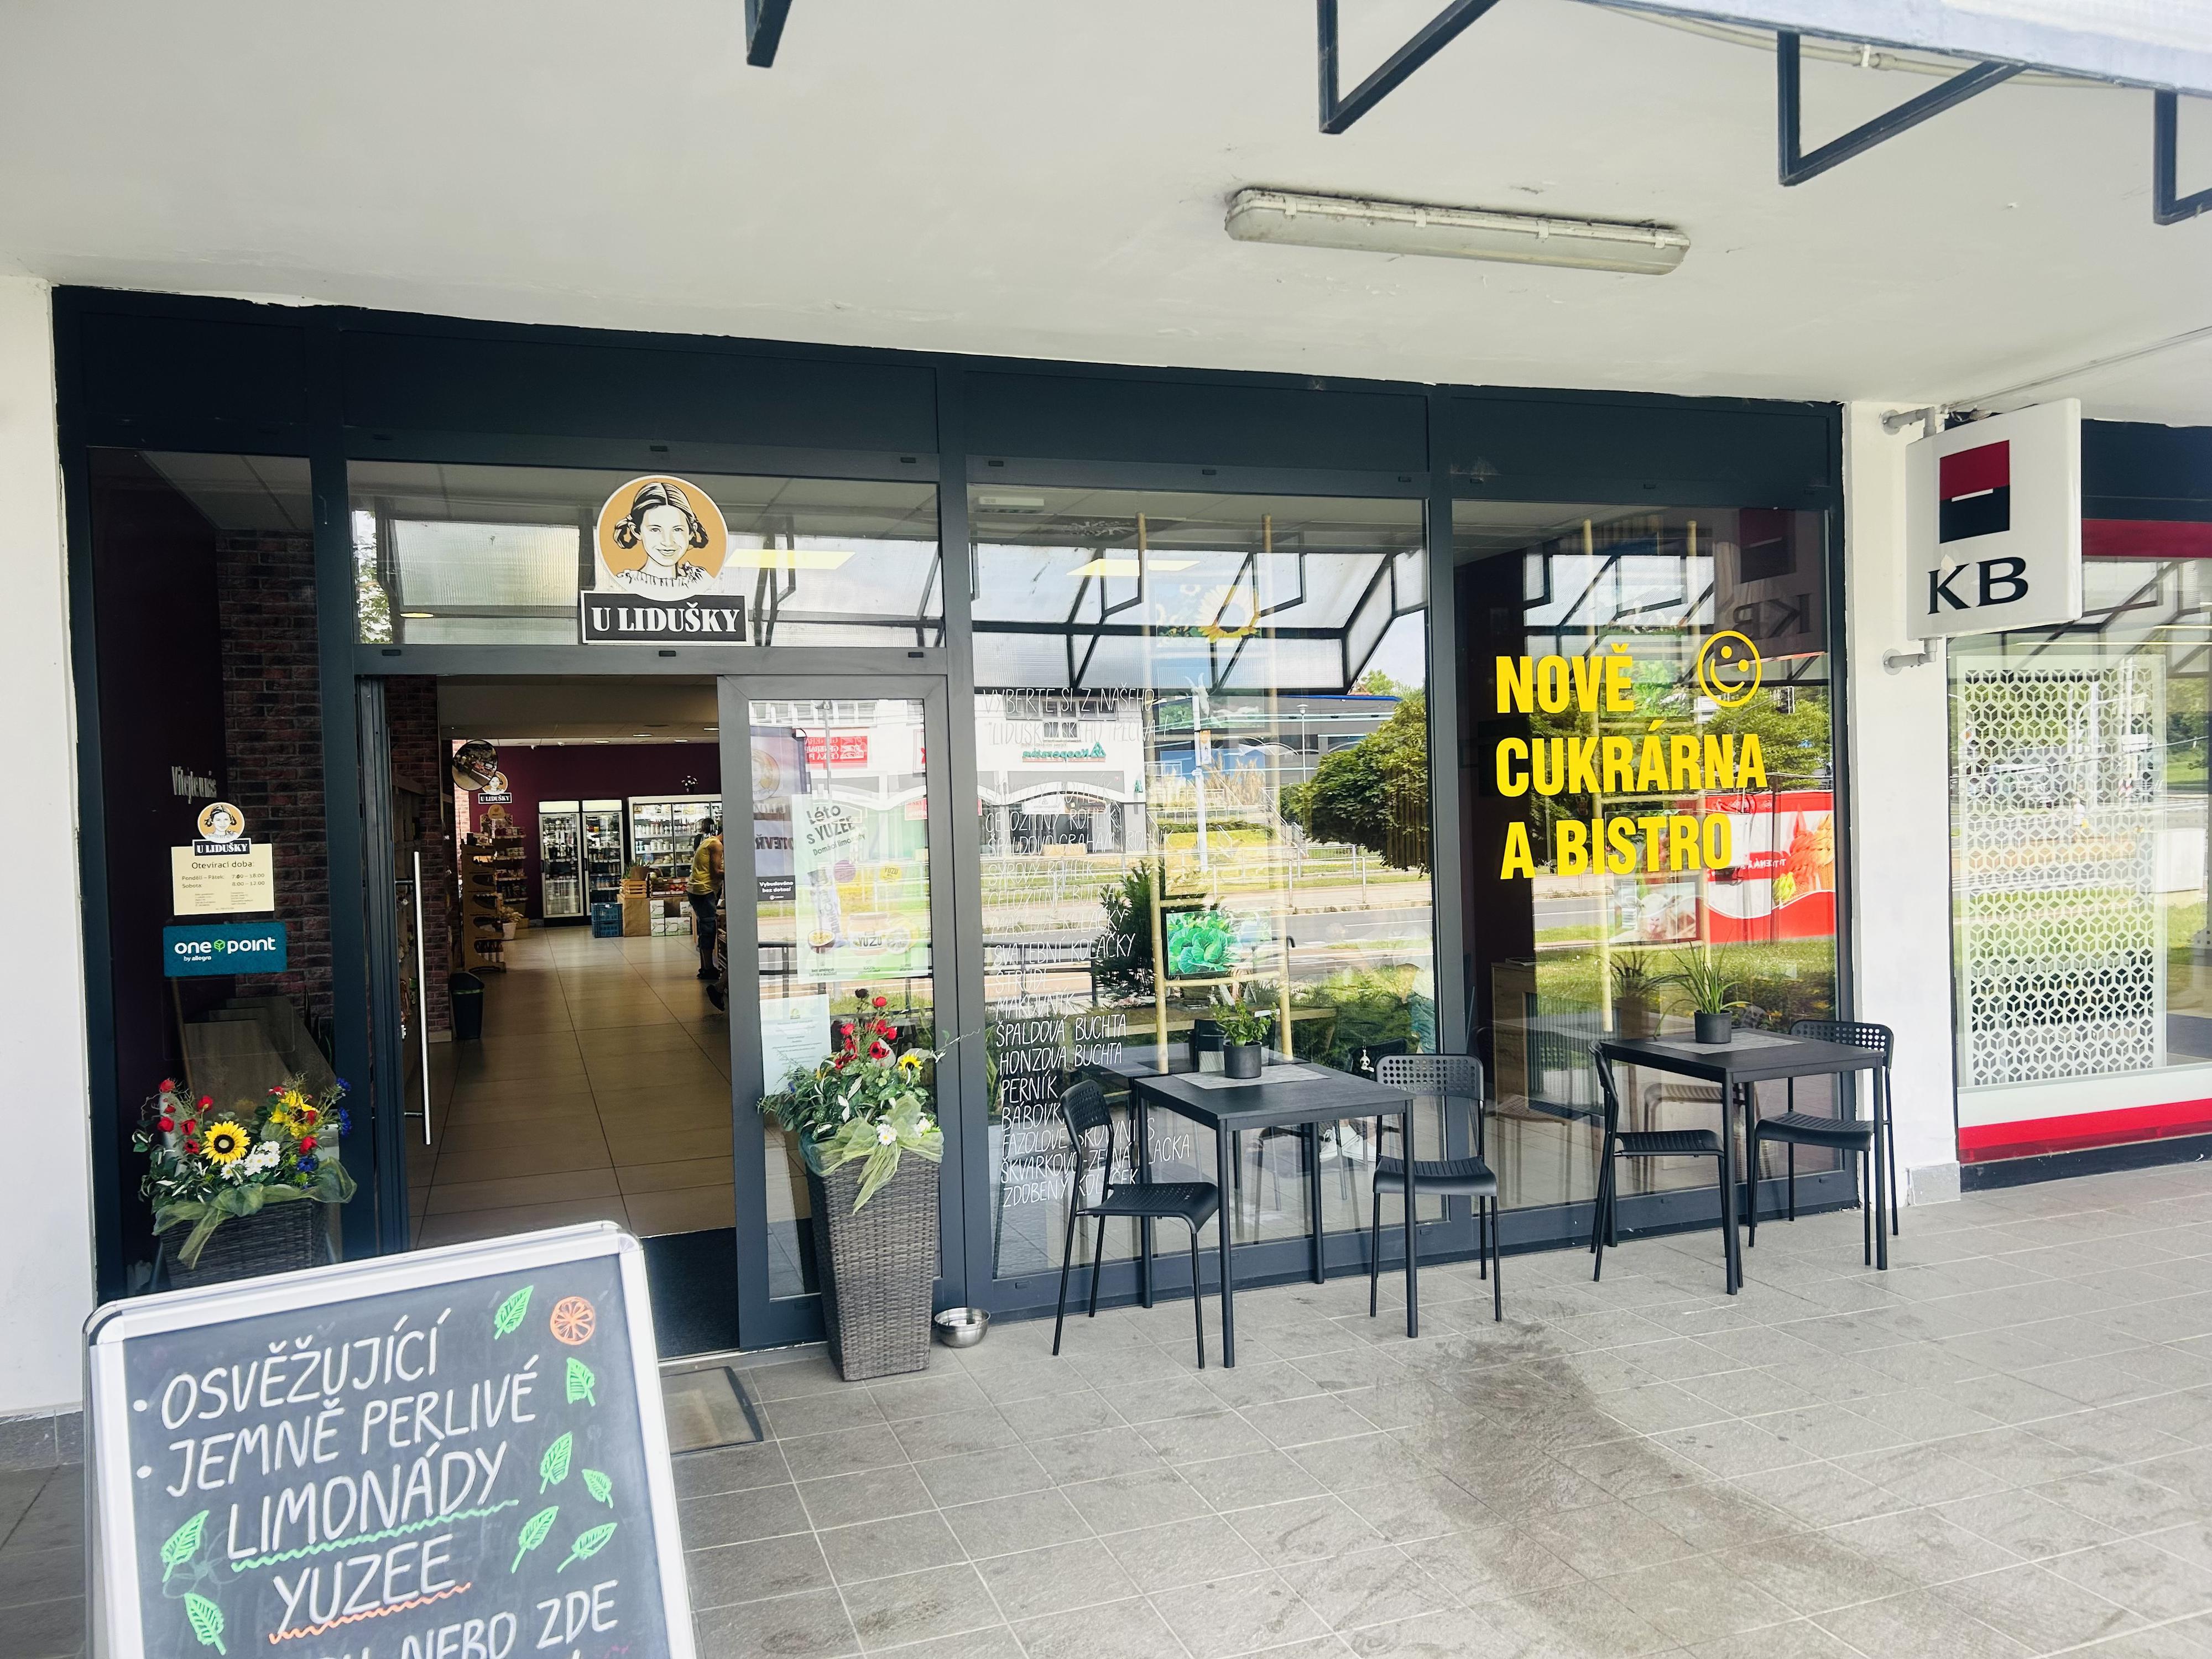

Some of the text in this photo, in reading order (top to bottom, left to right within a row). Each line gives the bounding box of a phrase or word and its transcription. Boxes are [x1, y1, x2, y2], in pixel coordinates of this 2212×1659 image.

[1927, 556, 2029, 615] KB
[591, 601, 740, 633] U LIDUŠKY
[1495, 643, 1635, 713] NOVĚ
[983, 682, 1155, 714] VYBERTE SI Z NAŠEHO
[1495, 719, 1768, 796] CUKRÁRNA
[196, 842, 248, 853] U LIDUŠKY
[1500, 812, 1732, 879] A BISTRO
[191, 861, 229, 869] Otevírací
[988, 853, 1040, 886] SÝROVÝ
[1073, 884, 1115, 906] BULKA
[1062, 904, 1126, 935] KOLÁČKY
[174, 937, 276, 954] one point
[858, 936, 882, 948] YUZU
[994, 931, 1136, 966] SVATEBNÍ KOLÁČKY
[995, 985, 1078, 1020] MAKOVNÍK
[996, 1013, 1127, 1047] ŠPALDOVÁ BUCHTA
[1074, 1042, 1123, 1067] BUCHTA
[1000, 1069, 1058, 1107] PERNÍK
[1001, 1100, 1066, 1132] BÁBOVK
[1003, 1173, 1069, 1208] ZDOBENÝ
[161, 1308, 452, 1430] OSVĚŽUJÍCÍ
[166, 1354, 539, 1498] JEMNĚ PERLIVÉ
[227, 1441, 507, 1559] LIMONÁDY
[272, 1533, 456, 1635] YUZEE
[402, 1579, 618, 1659] NEBO ZDE
